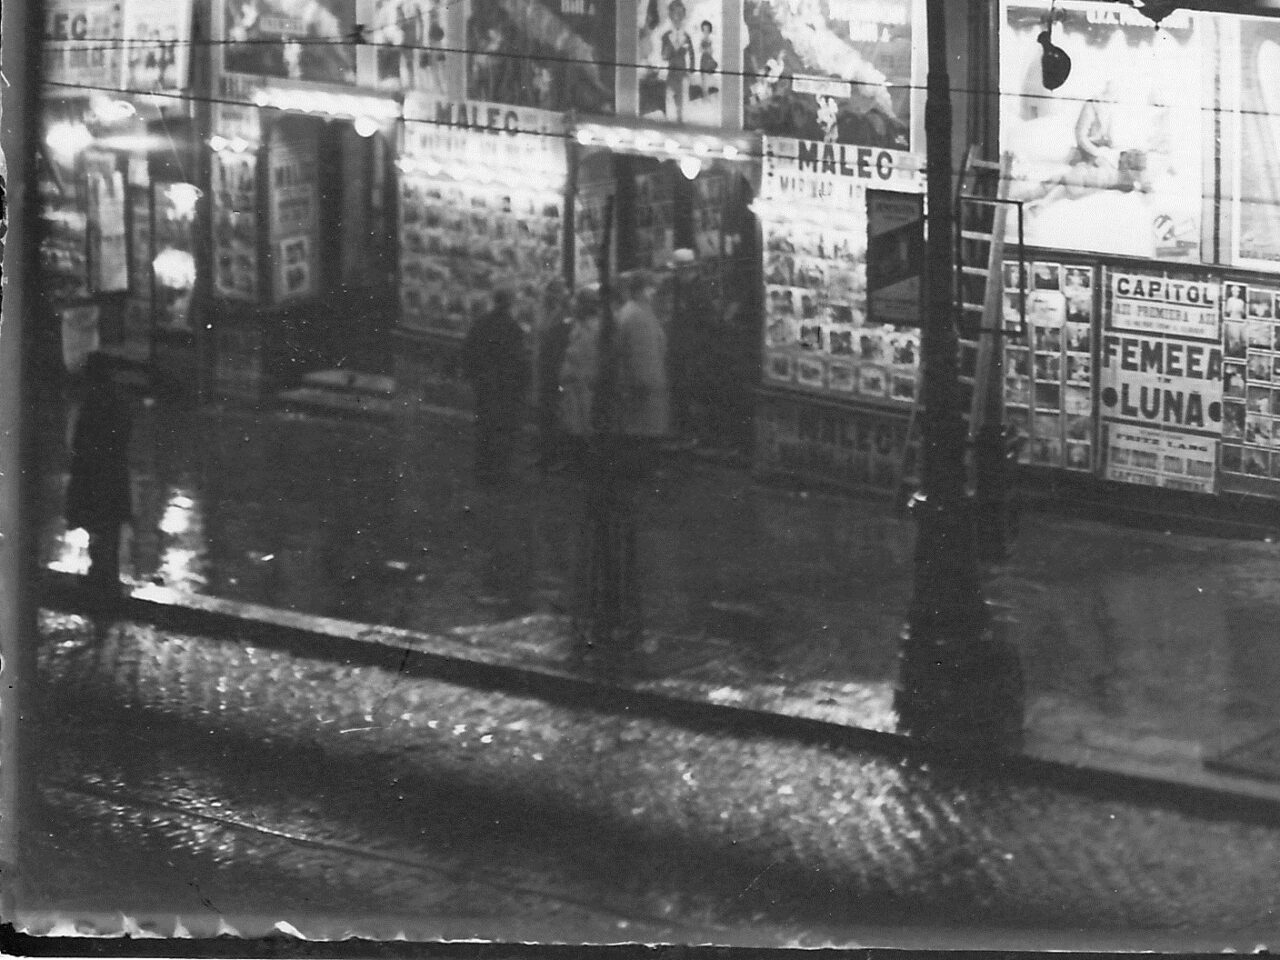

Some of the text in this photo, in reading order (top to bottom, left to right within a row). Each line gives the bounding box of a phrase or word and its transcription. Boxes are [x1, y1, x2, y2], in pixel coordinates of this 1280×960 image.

[799, 139, 895, 181] MALEC
[1116, 277, 1214, 305] CAPITOL
[1102, 335, 1222, 382] FEMEEA
[1120, 382, 1204, 428] LUNA
